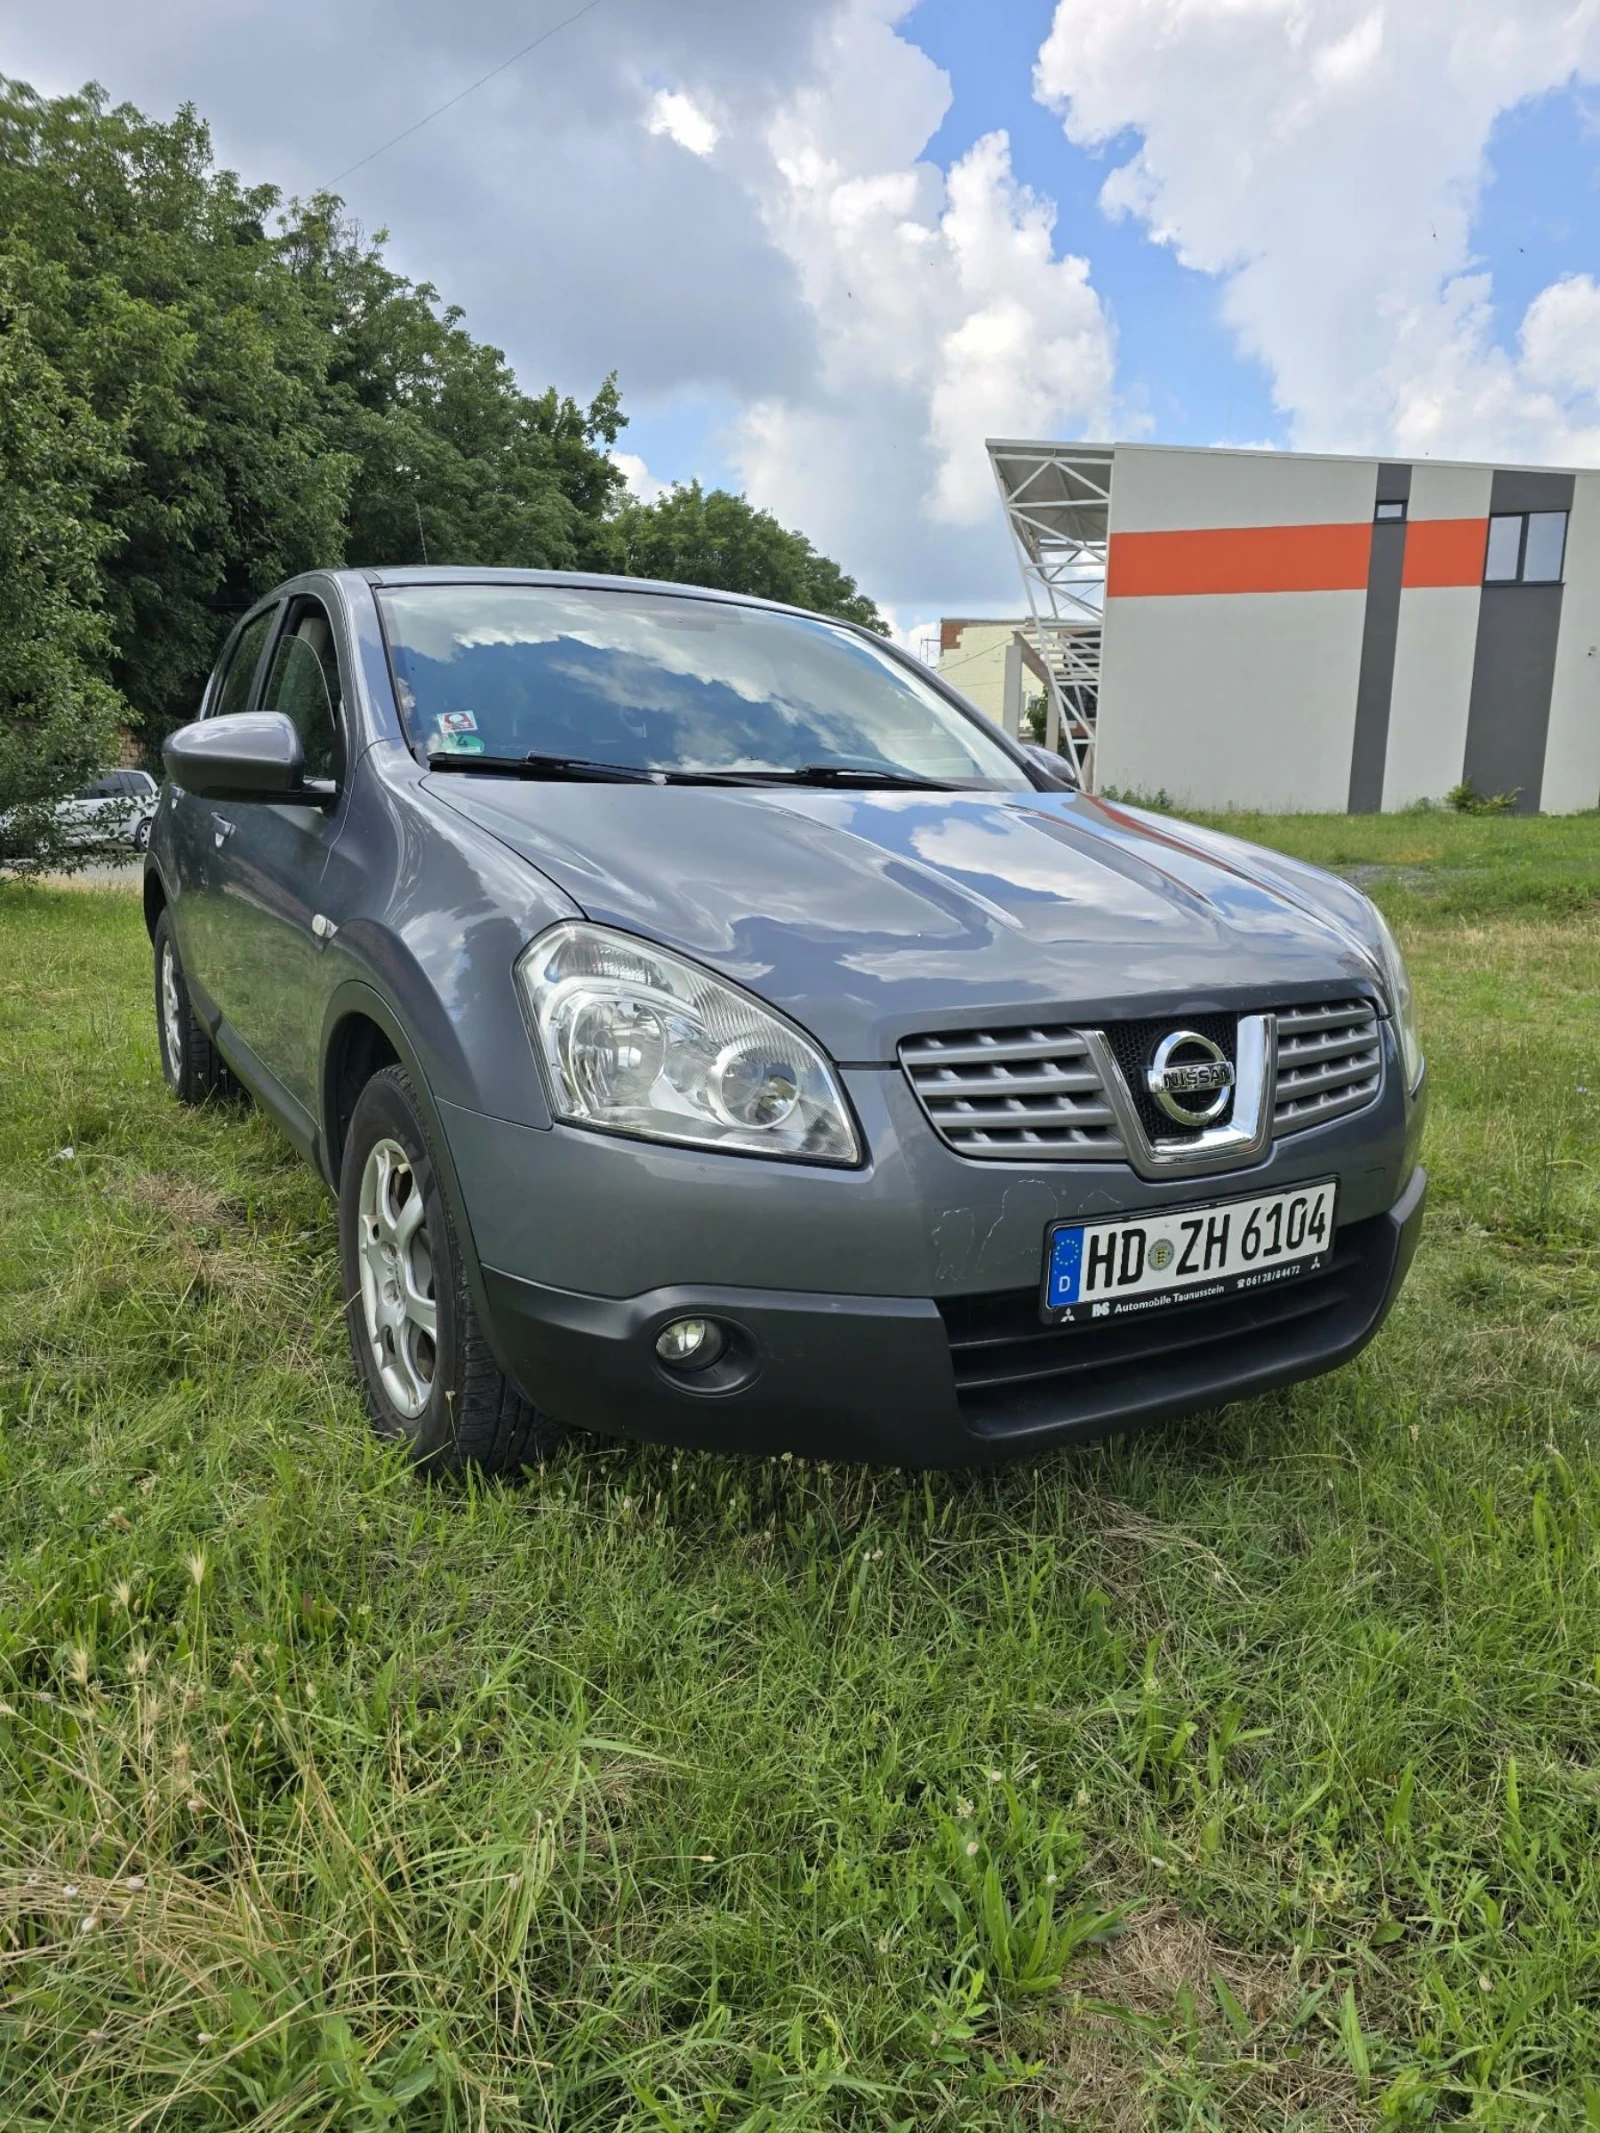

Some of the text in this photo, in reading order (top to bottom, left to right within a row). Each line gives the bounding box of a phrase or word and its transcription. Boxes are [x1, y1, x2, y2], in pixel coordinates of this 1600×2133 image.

[456, 736, 468, 748] 4
[1163, 1066, 1231, 1089] NISSAN
[1086, 1193, 1326, 1291] HD ZH 6104
[1058, 1275, 1071, 1293] D
[1114, 1295, 1171, 1314] Automobile
[1173, 1284, 1225, 1303] Taunusstein
